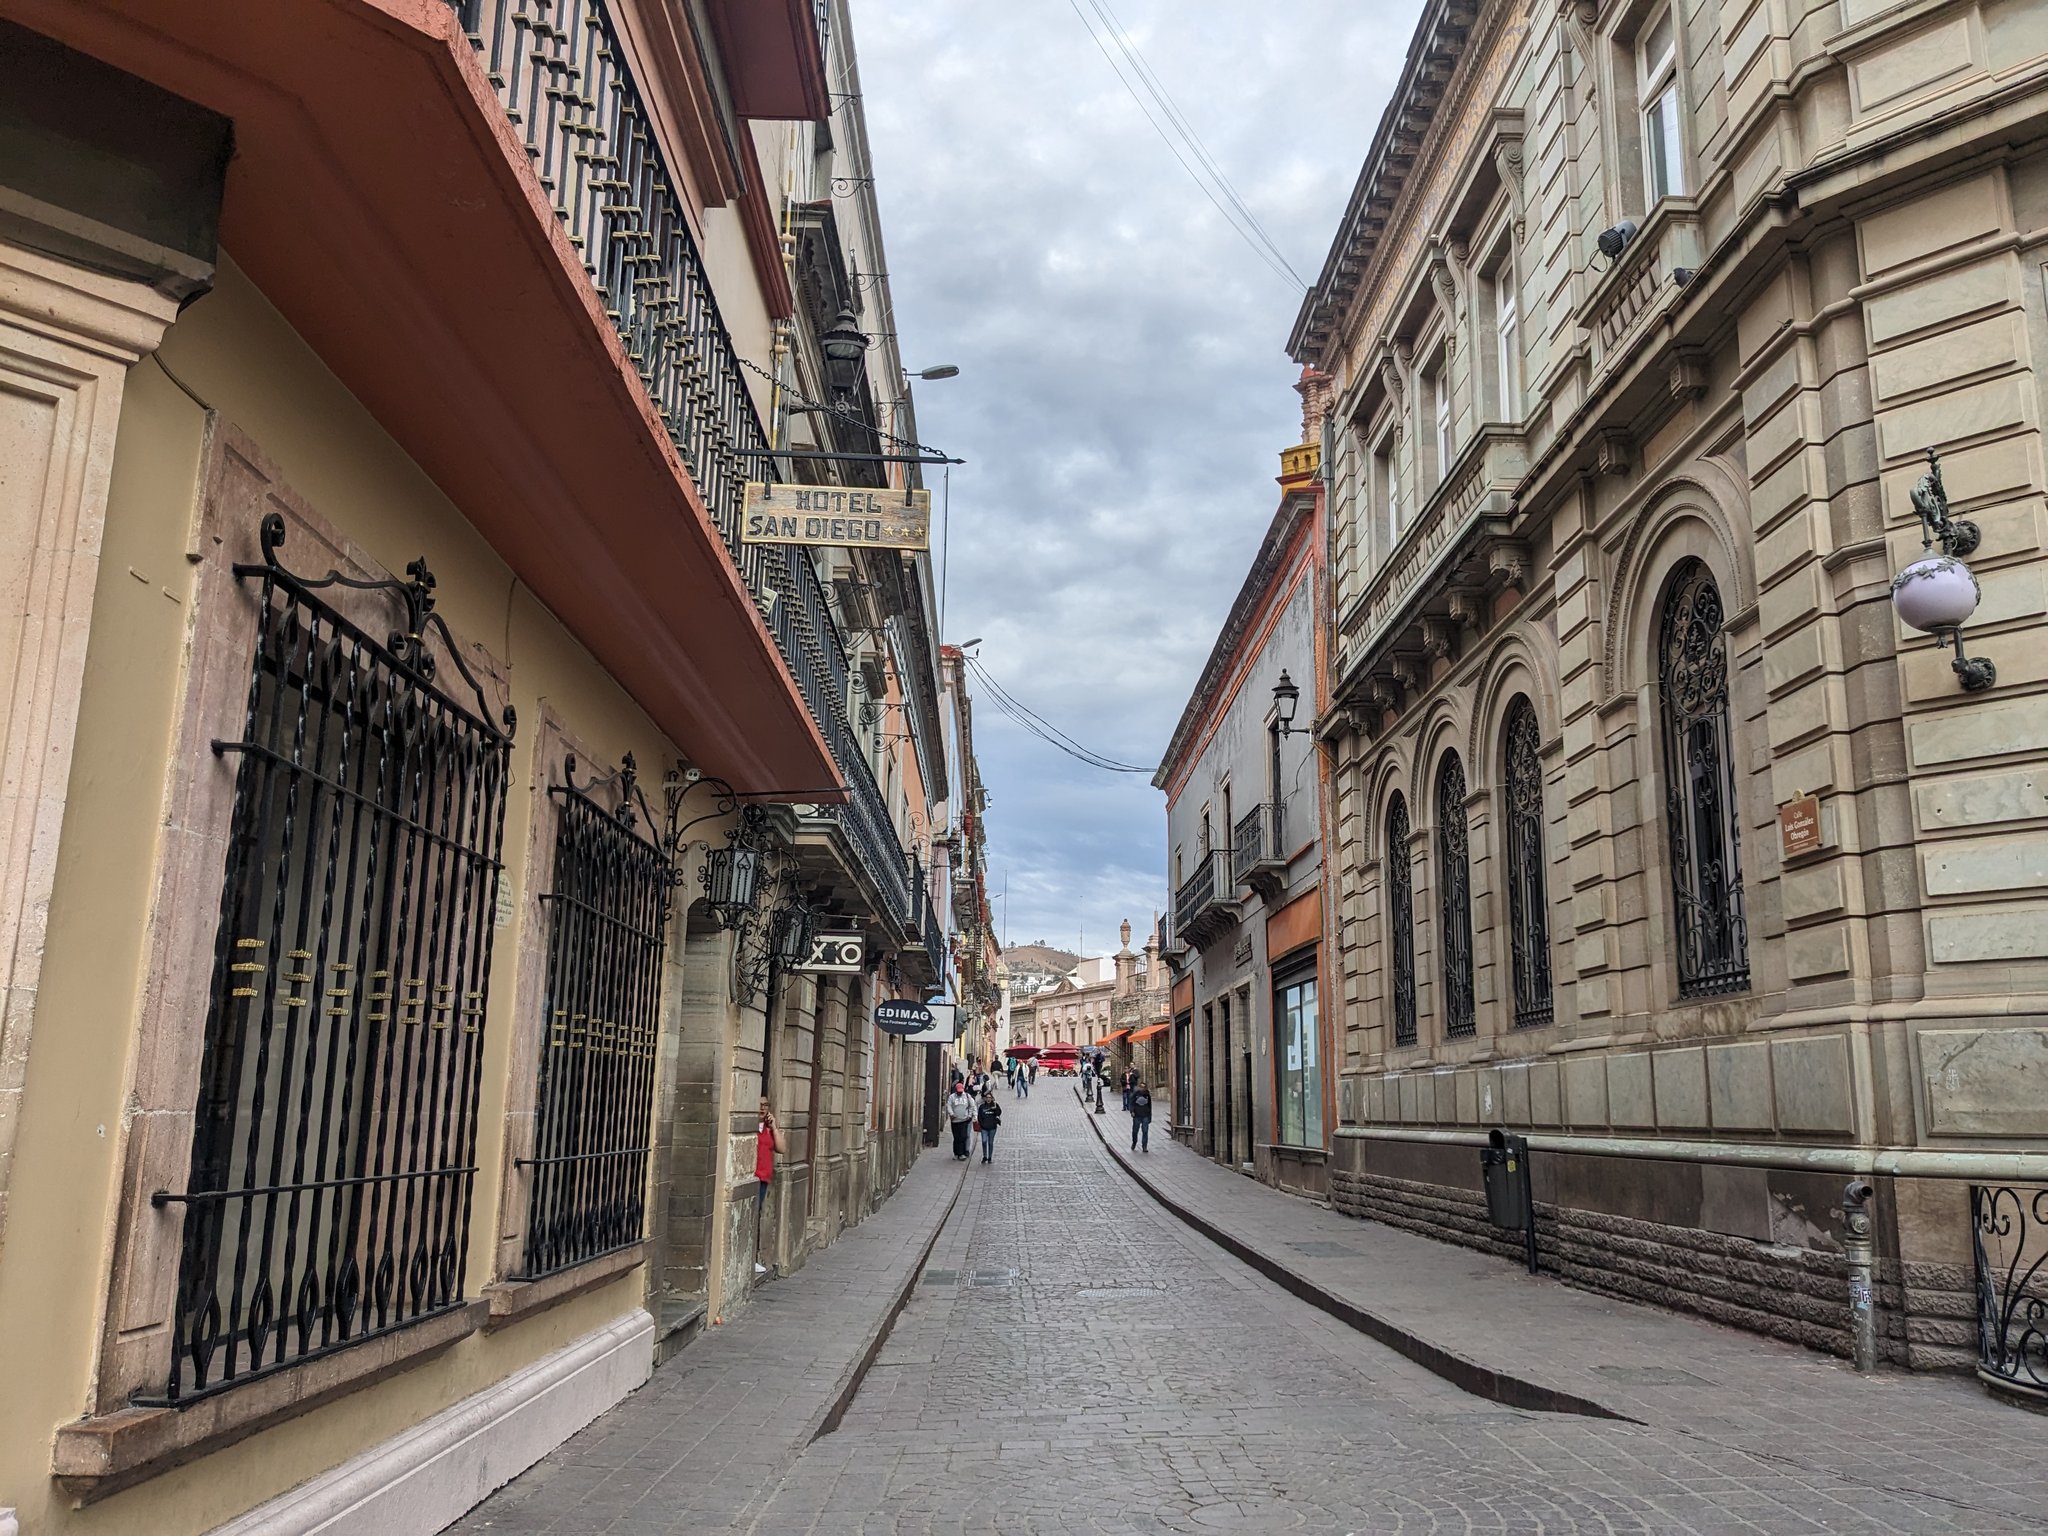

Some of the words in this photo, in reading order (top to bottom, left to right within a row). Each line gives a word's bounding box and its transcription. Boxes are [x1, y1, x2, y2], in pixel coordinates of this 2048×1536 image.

[795, 490, 882, 513] HOTEL
[748, 516, 797, 538] SAN
[805, 517, 881, 541] DIEGO
[1785, 823, 1794, 832] Luis
[1794, 817, 1813, 829] González
[1791, 828, 1809, 840] Obregón
[877, 1007, 929, 1021] EDIMAG
